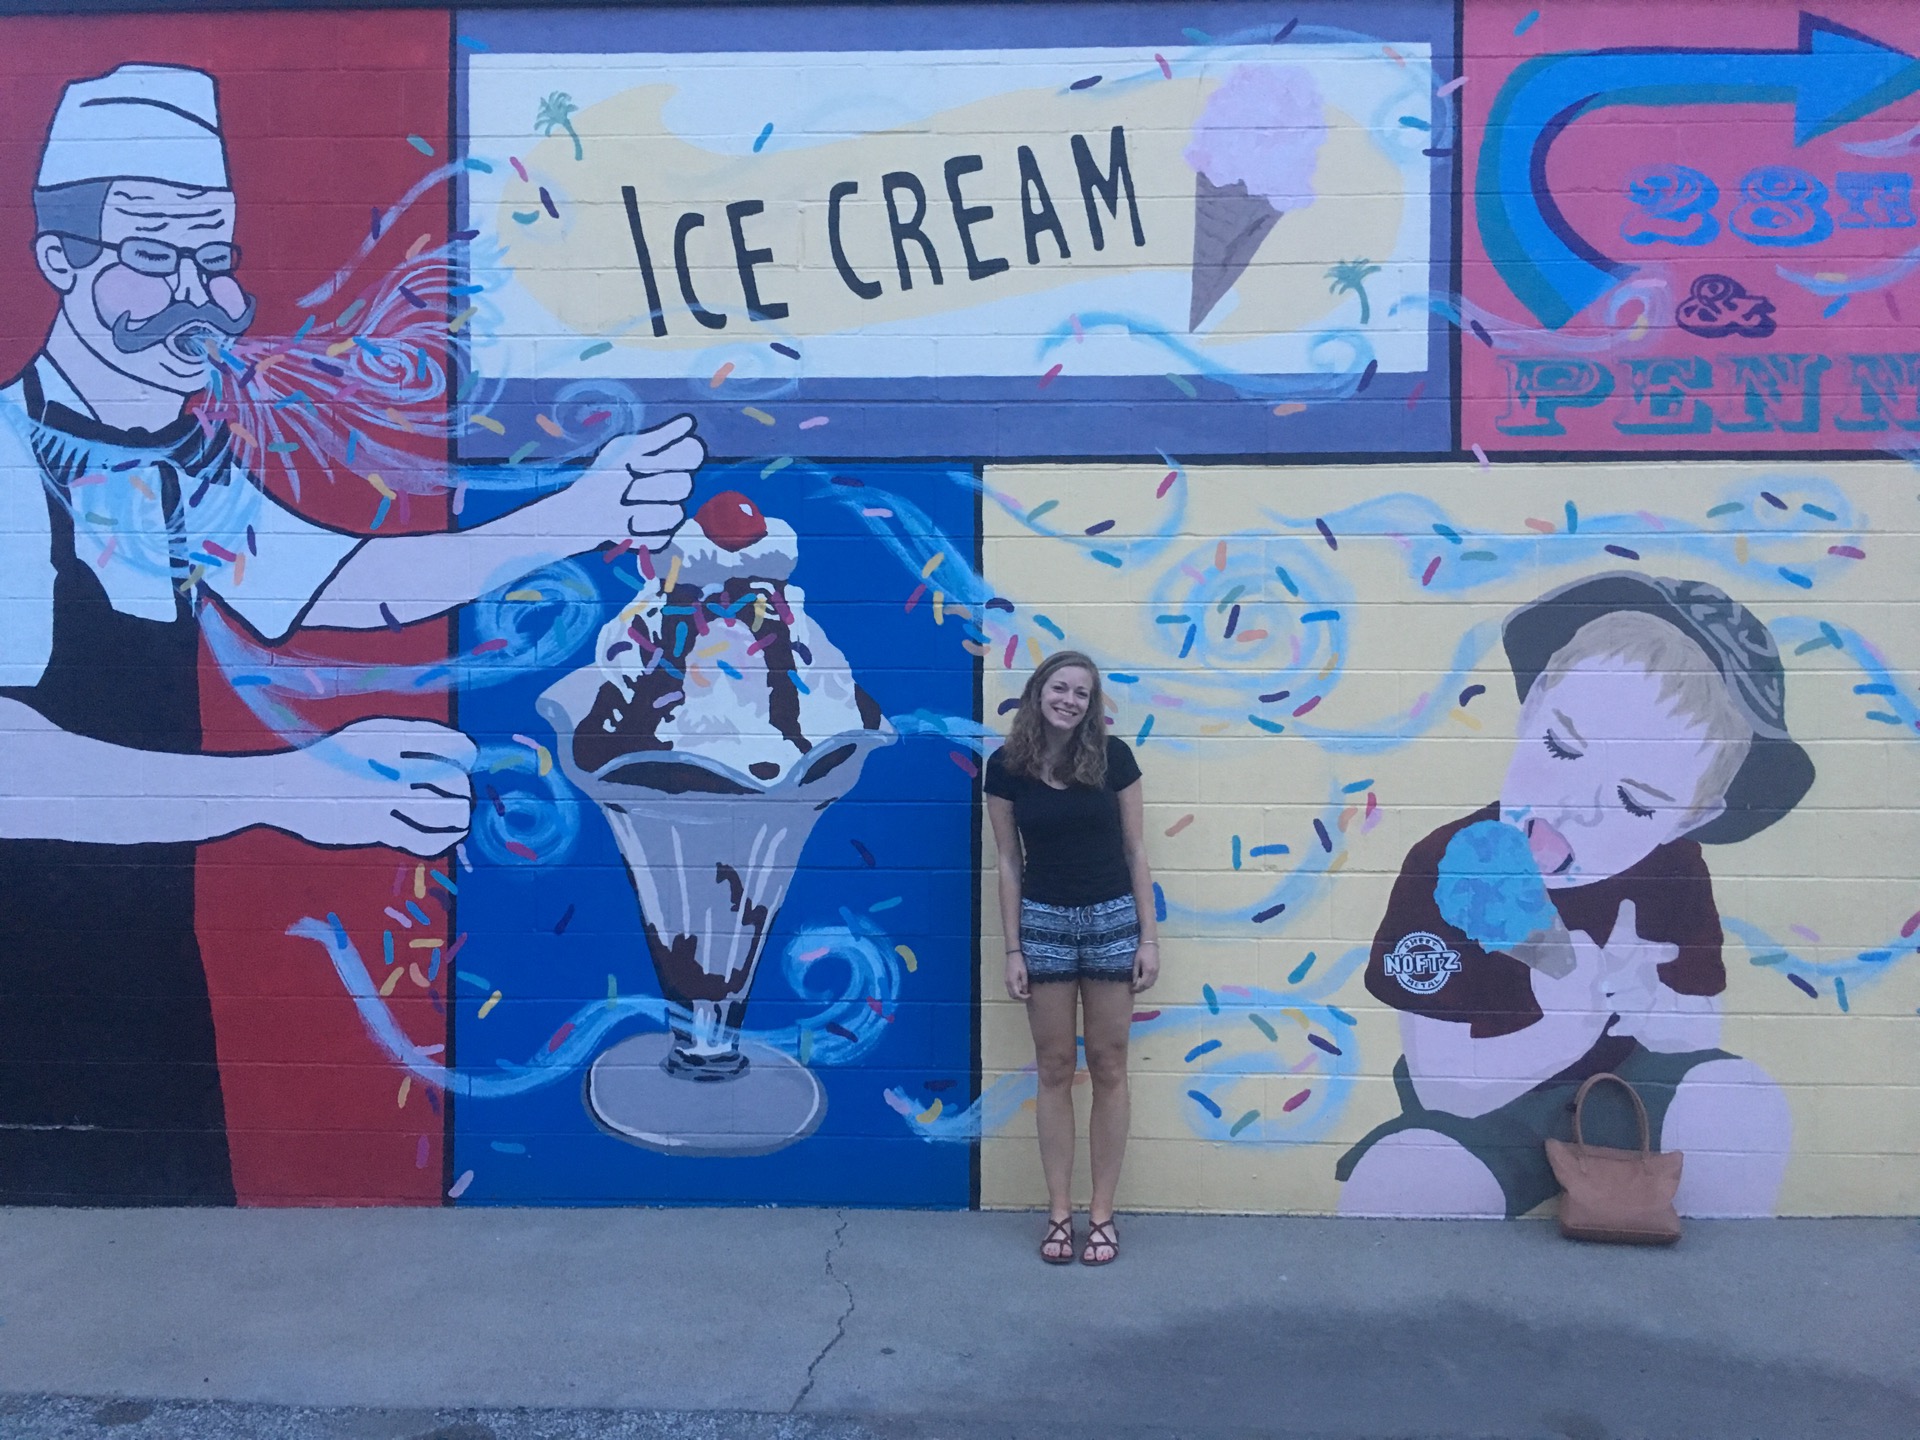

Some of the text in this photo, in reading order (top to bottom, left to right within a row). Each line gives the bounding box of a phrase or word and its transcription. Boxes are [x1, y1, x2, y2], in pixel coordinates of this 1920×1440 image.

[621, 126, 1146, 337] ICE CREAM
[1675, 273, 1777, 339] &
[1495, 353, 1920, 437] PENN
[1384, 951, 1460, 974] NOFTZ
[1404, 937, 1438, 949] SHEET
[1406, 978, 1440, 989] METAL
